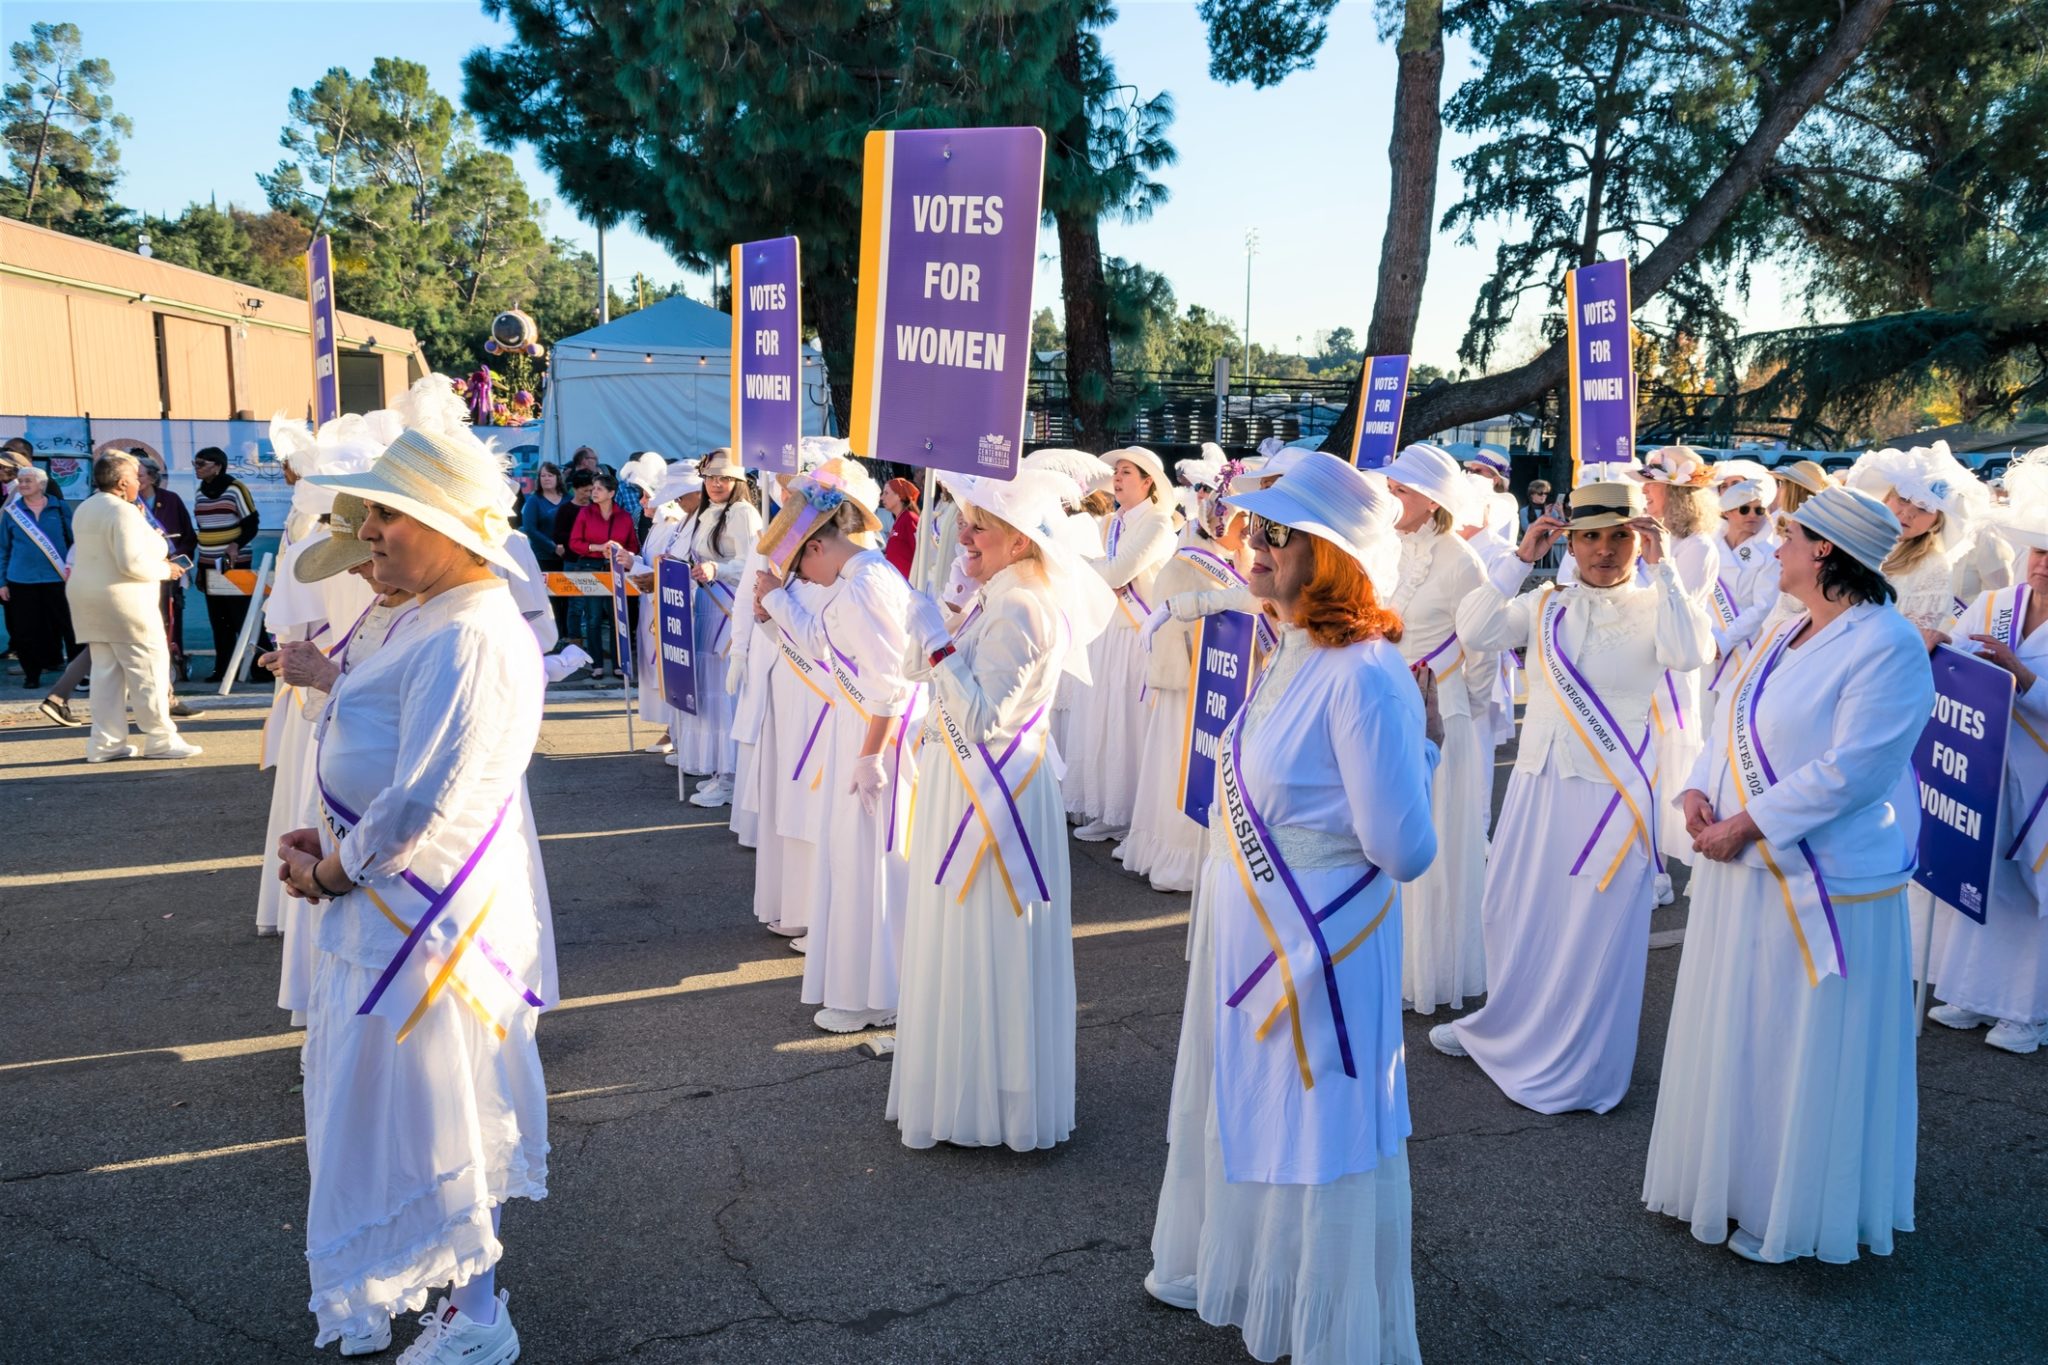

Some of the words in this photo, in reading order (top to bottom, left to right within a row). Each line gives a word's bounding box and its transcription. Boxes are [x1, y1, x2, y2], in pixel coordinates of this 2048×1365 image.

[913, 194, 1003, 235] VOTES
[750, 282, 786, 311] VOTES
[924, 261, 981, 302] FOR
[1583, 299, 1616, 326] VOTES
[755, 330, 780, 355] FOR
[896, 324, 1006, 371] WOMEN
[1590, 339, 1612, 363] FOR
[746, 374, 791, 401] WOMEN
[1374, 377, 1399, 391] VOTES
[1583, 377, 1624, 401] WOMEN
[1374, 399, 1391, 413] FOR
[1365, 421, 1395, 435] WOMEN
[662, 586, 685, 608] VOTES
[1714, 583, 1726, 605] MEN
[1721, 605, 1735, 626] VOT
[667, 616, 682, 636] FOR
[1997, 608, 2012, 644] MICH
[662, 642, 691, 667] WOMEN
[781, 643, 813, 674] PROJECT
[1206, 646, 1238, 680] VOTES
[835, 668, 866, 704] PROJECT
[1545, 643, 1567, 686] COUNCIL
[1562, 684, 1590, 717] NEGRO
[1586, 715, 1617, 753] WOMEN
[1205, 689, 1227, 720] FOR
[1195, 727, 1219, 761] WOM
[1736, 680, 1754, 771] CELEBRATES
[1745, 771, 1764, 797] 202
[1931, 740, 1969, 784] FOR
